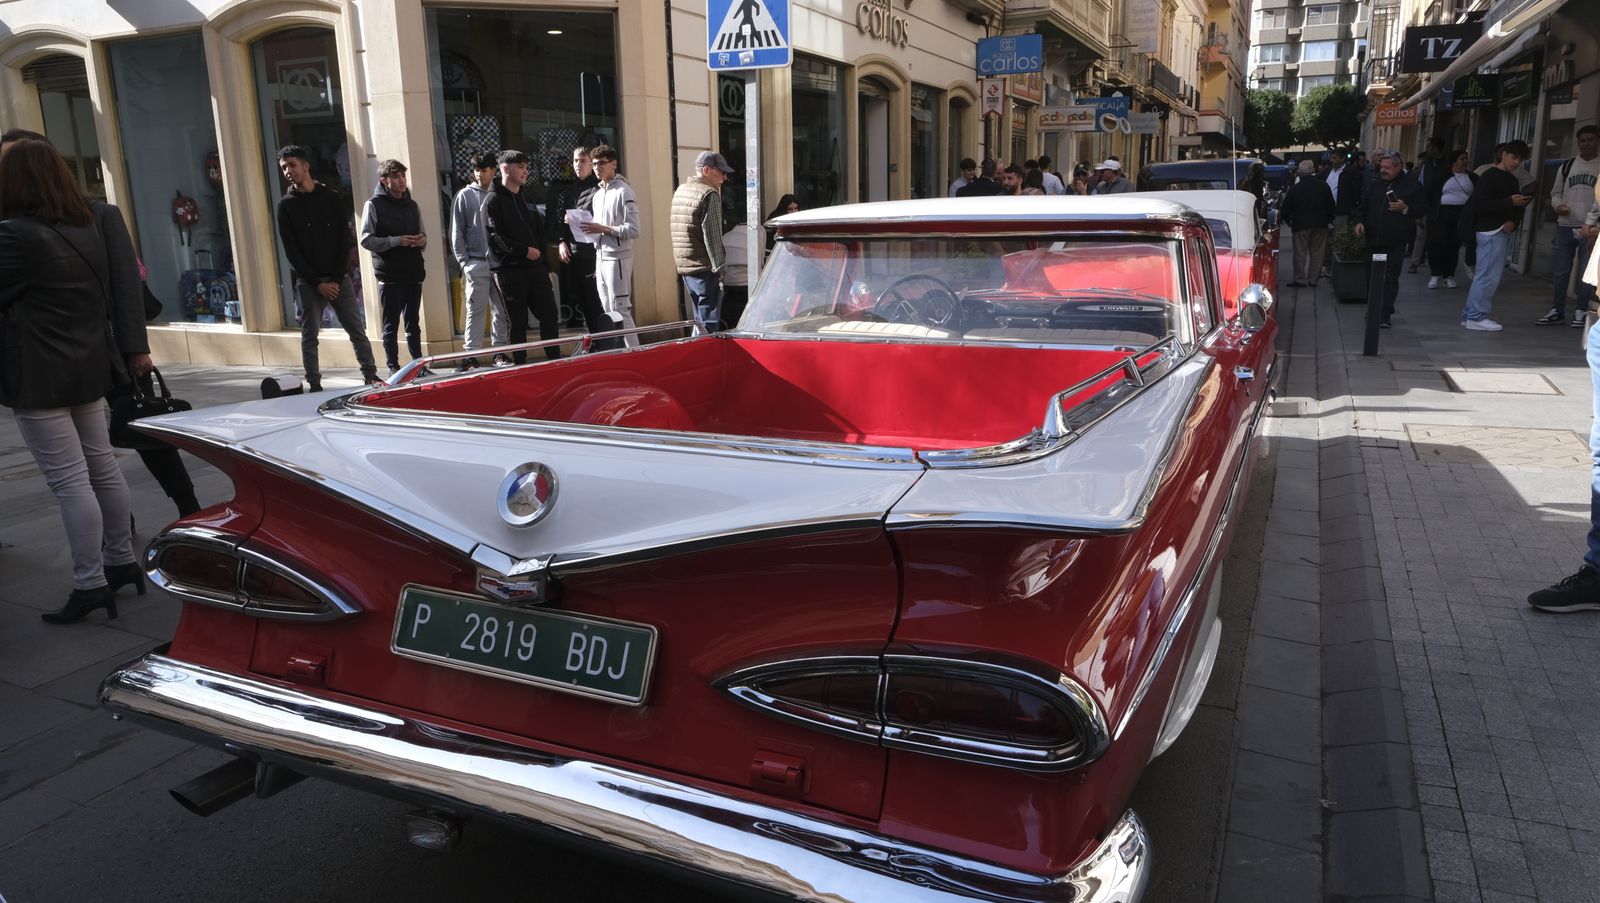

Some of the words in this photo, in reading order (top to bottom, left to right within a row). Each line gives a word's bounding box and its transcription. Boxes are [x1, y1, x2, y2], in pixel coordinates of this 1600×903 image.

[855, 2, 909, 50] carlos
[1420, 37, 1462, 60] TZ
[980, 51, 1039, 73] carlos
[1378, 109, 1415, 118] carlos
[411, 602, 432, 639] P
[460, 612, 537, 661] 2819
[565, 631, 630, 680] BDJ
